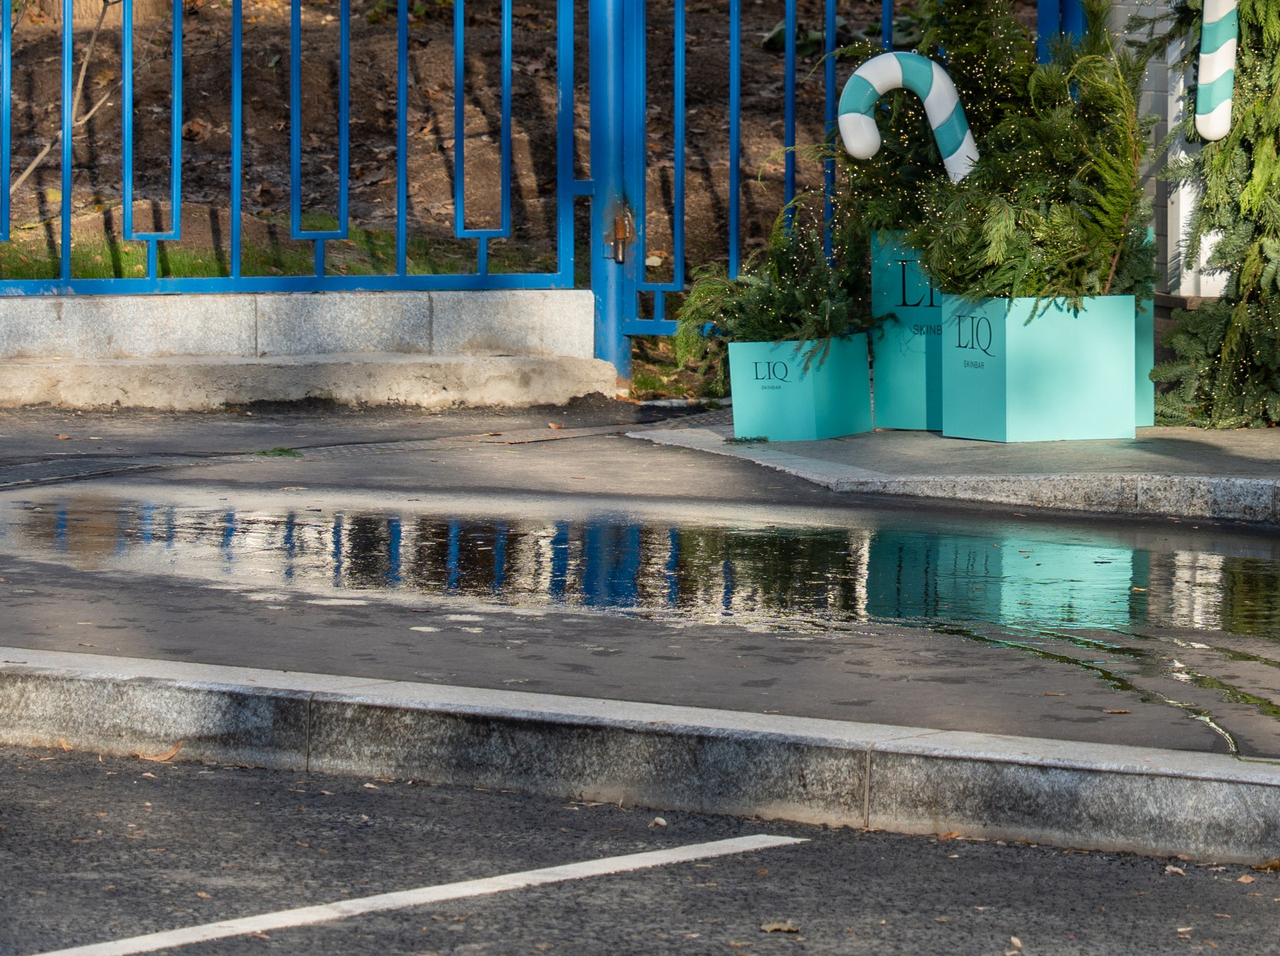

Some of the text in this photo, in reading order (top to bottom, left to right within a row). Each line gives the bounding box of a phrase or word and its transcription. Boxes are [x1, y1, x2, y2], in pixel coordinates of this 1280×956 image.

[894, 259, 942, 307] LI
[913, 324, 942, 336] SKINB
[955, 314, 996, 358] LIQ
[752, 361, 792, 383] LIQ
[963, 359, 985, 369] SKINBAR
